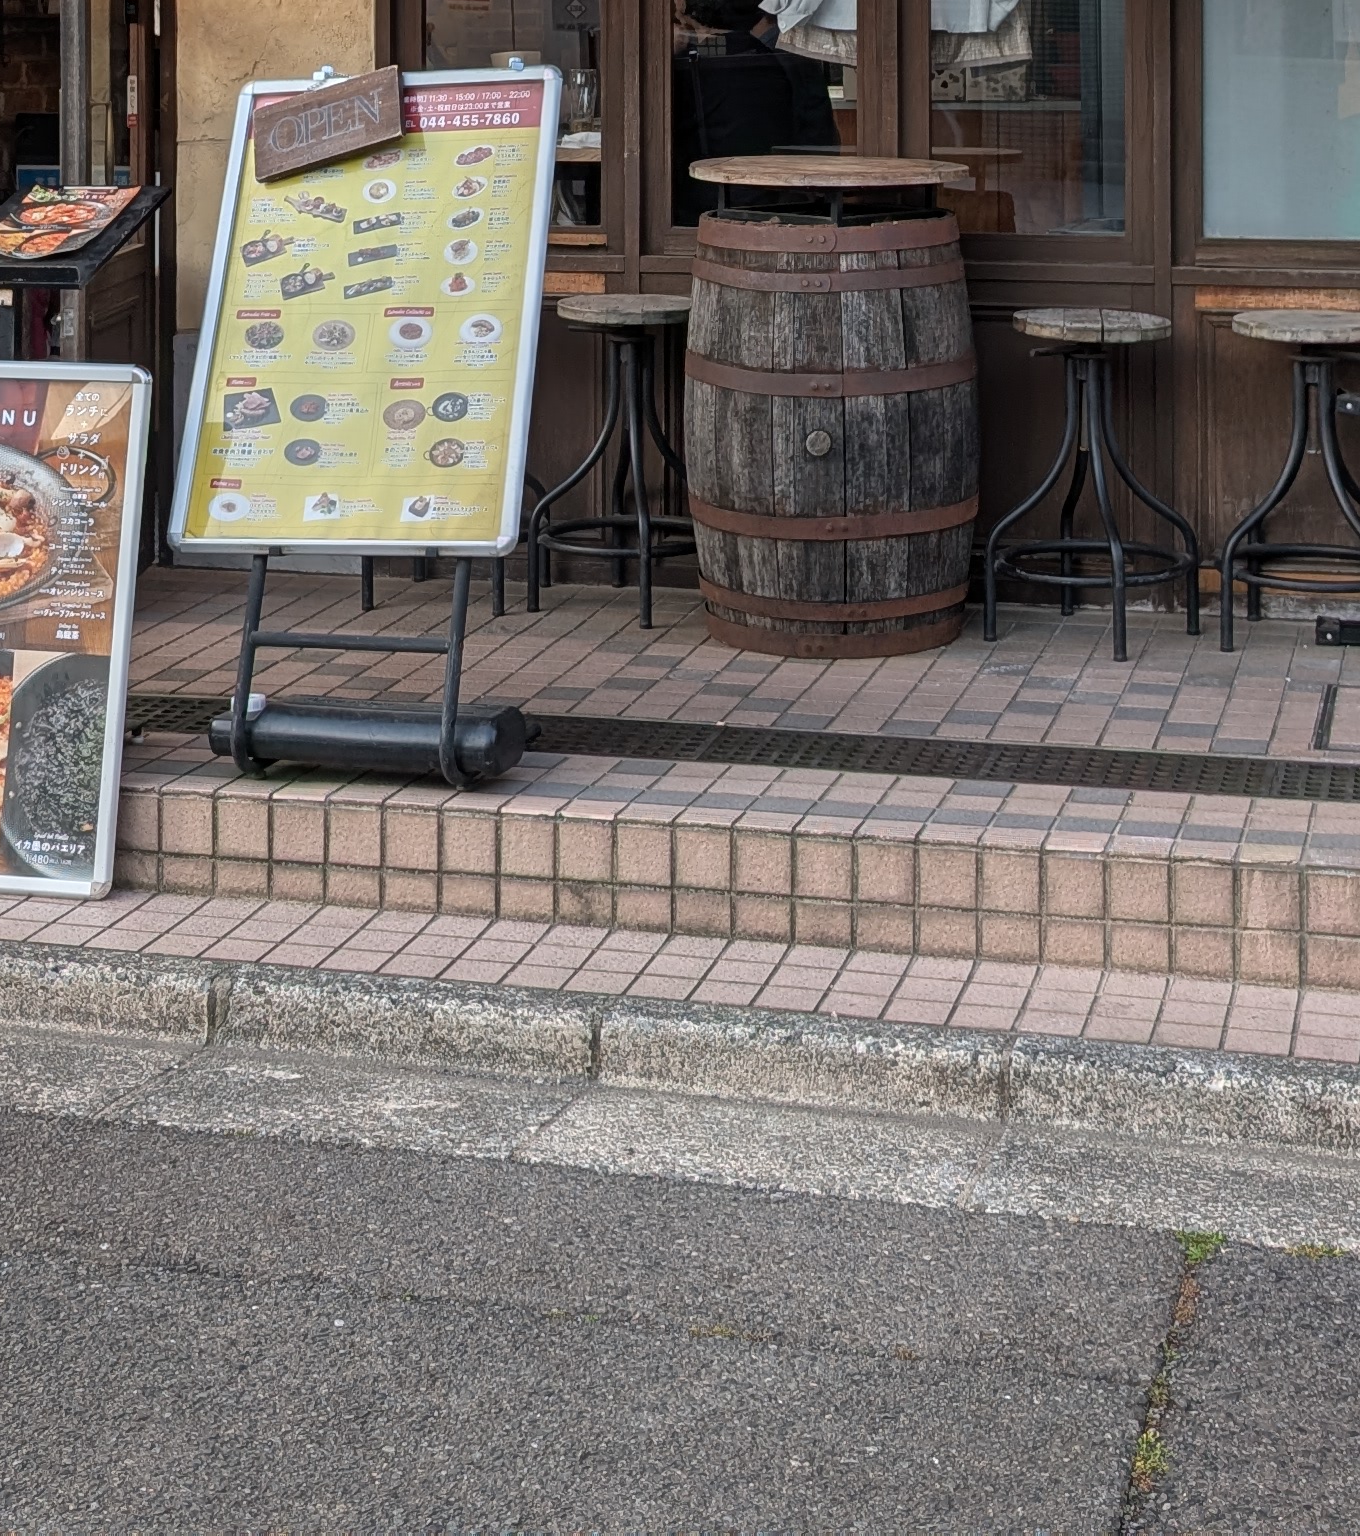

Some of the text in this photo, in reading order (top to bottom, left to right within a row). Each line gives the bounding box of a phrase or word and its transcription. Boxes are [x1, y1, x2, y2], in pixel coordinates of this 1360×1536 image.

[429, 94, 448, 103] 11:30
[456, 92, 475, 101] 15:00
[482, 91, 502, 100] 17:00
[270, 88, 383, 153] OPEN
[420, 112, 520, 129] 044-455-7860
[75, 392, 100, 402] 全ての
[65, 405, 109, 417] ランチに
[68, 433, 101, 445] サラダ
[51, 499, 107, 508] ジンジャーエール
[60, 517, 95, 526] コカコーラ
[50, 566, 70, 575] ティー
[14, 840, 86, 854] イカ墨のパエリア
